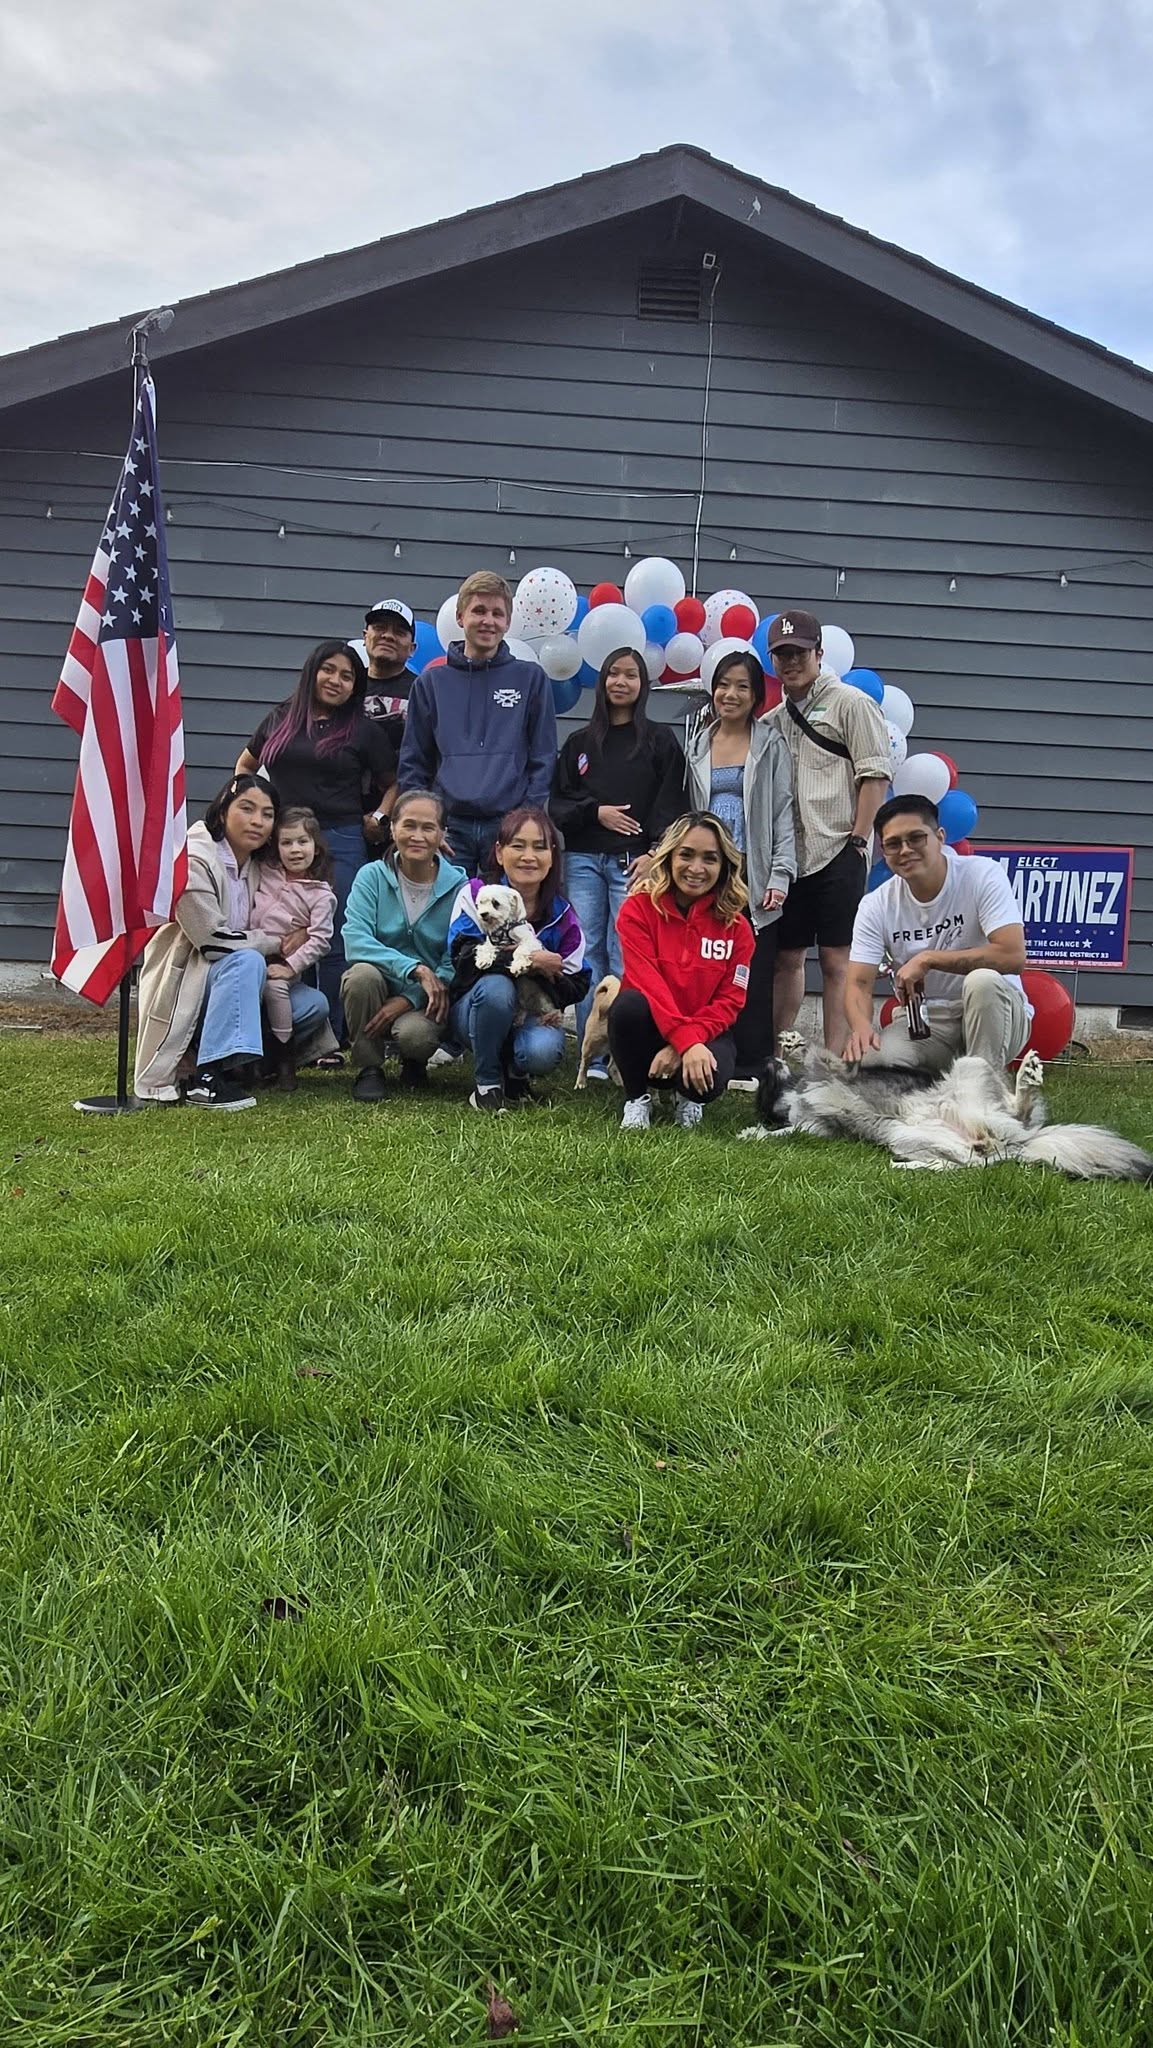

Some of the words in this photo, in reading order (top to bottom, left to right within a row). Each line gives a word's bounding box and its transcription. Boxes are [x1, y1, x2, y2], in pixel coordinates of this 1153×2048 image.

[782, 618, 794, 634] LA
[1017, 856, 1059, 868] ELECT
[999, 857, 1124, 924] ARTINEZ
[892, 913, 965, 944] FREEDOM
[1049, 940, 1080, 948] CHANGE
